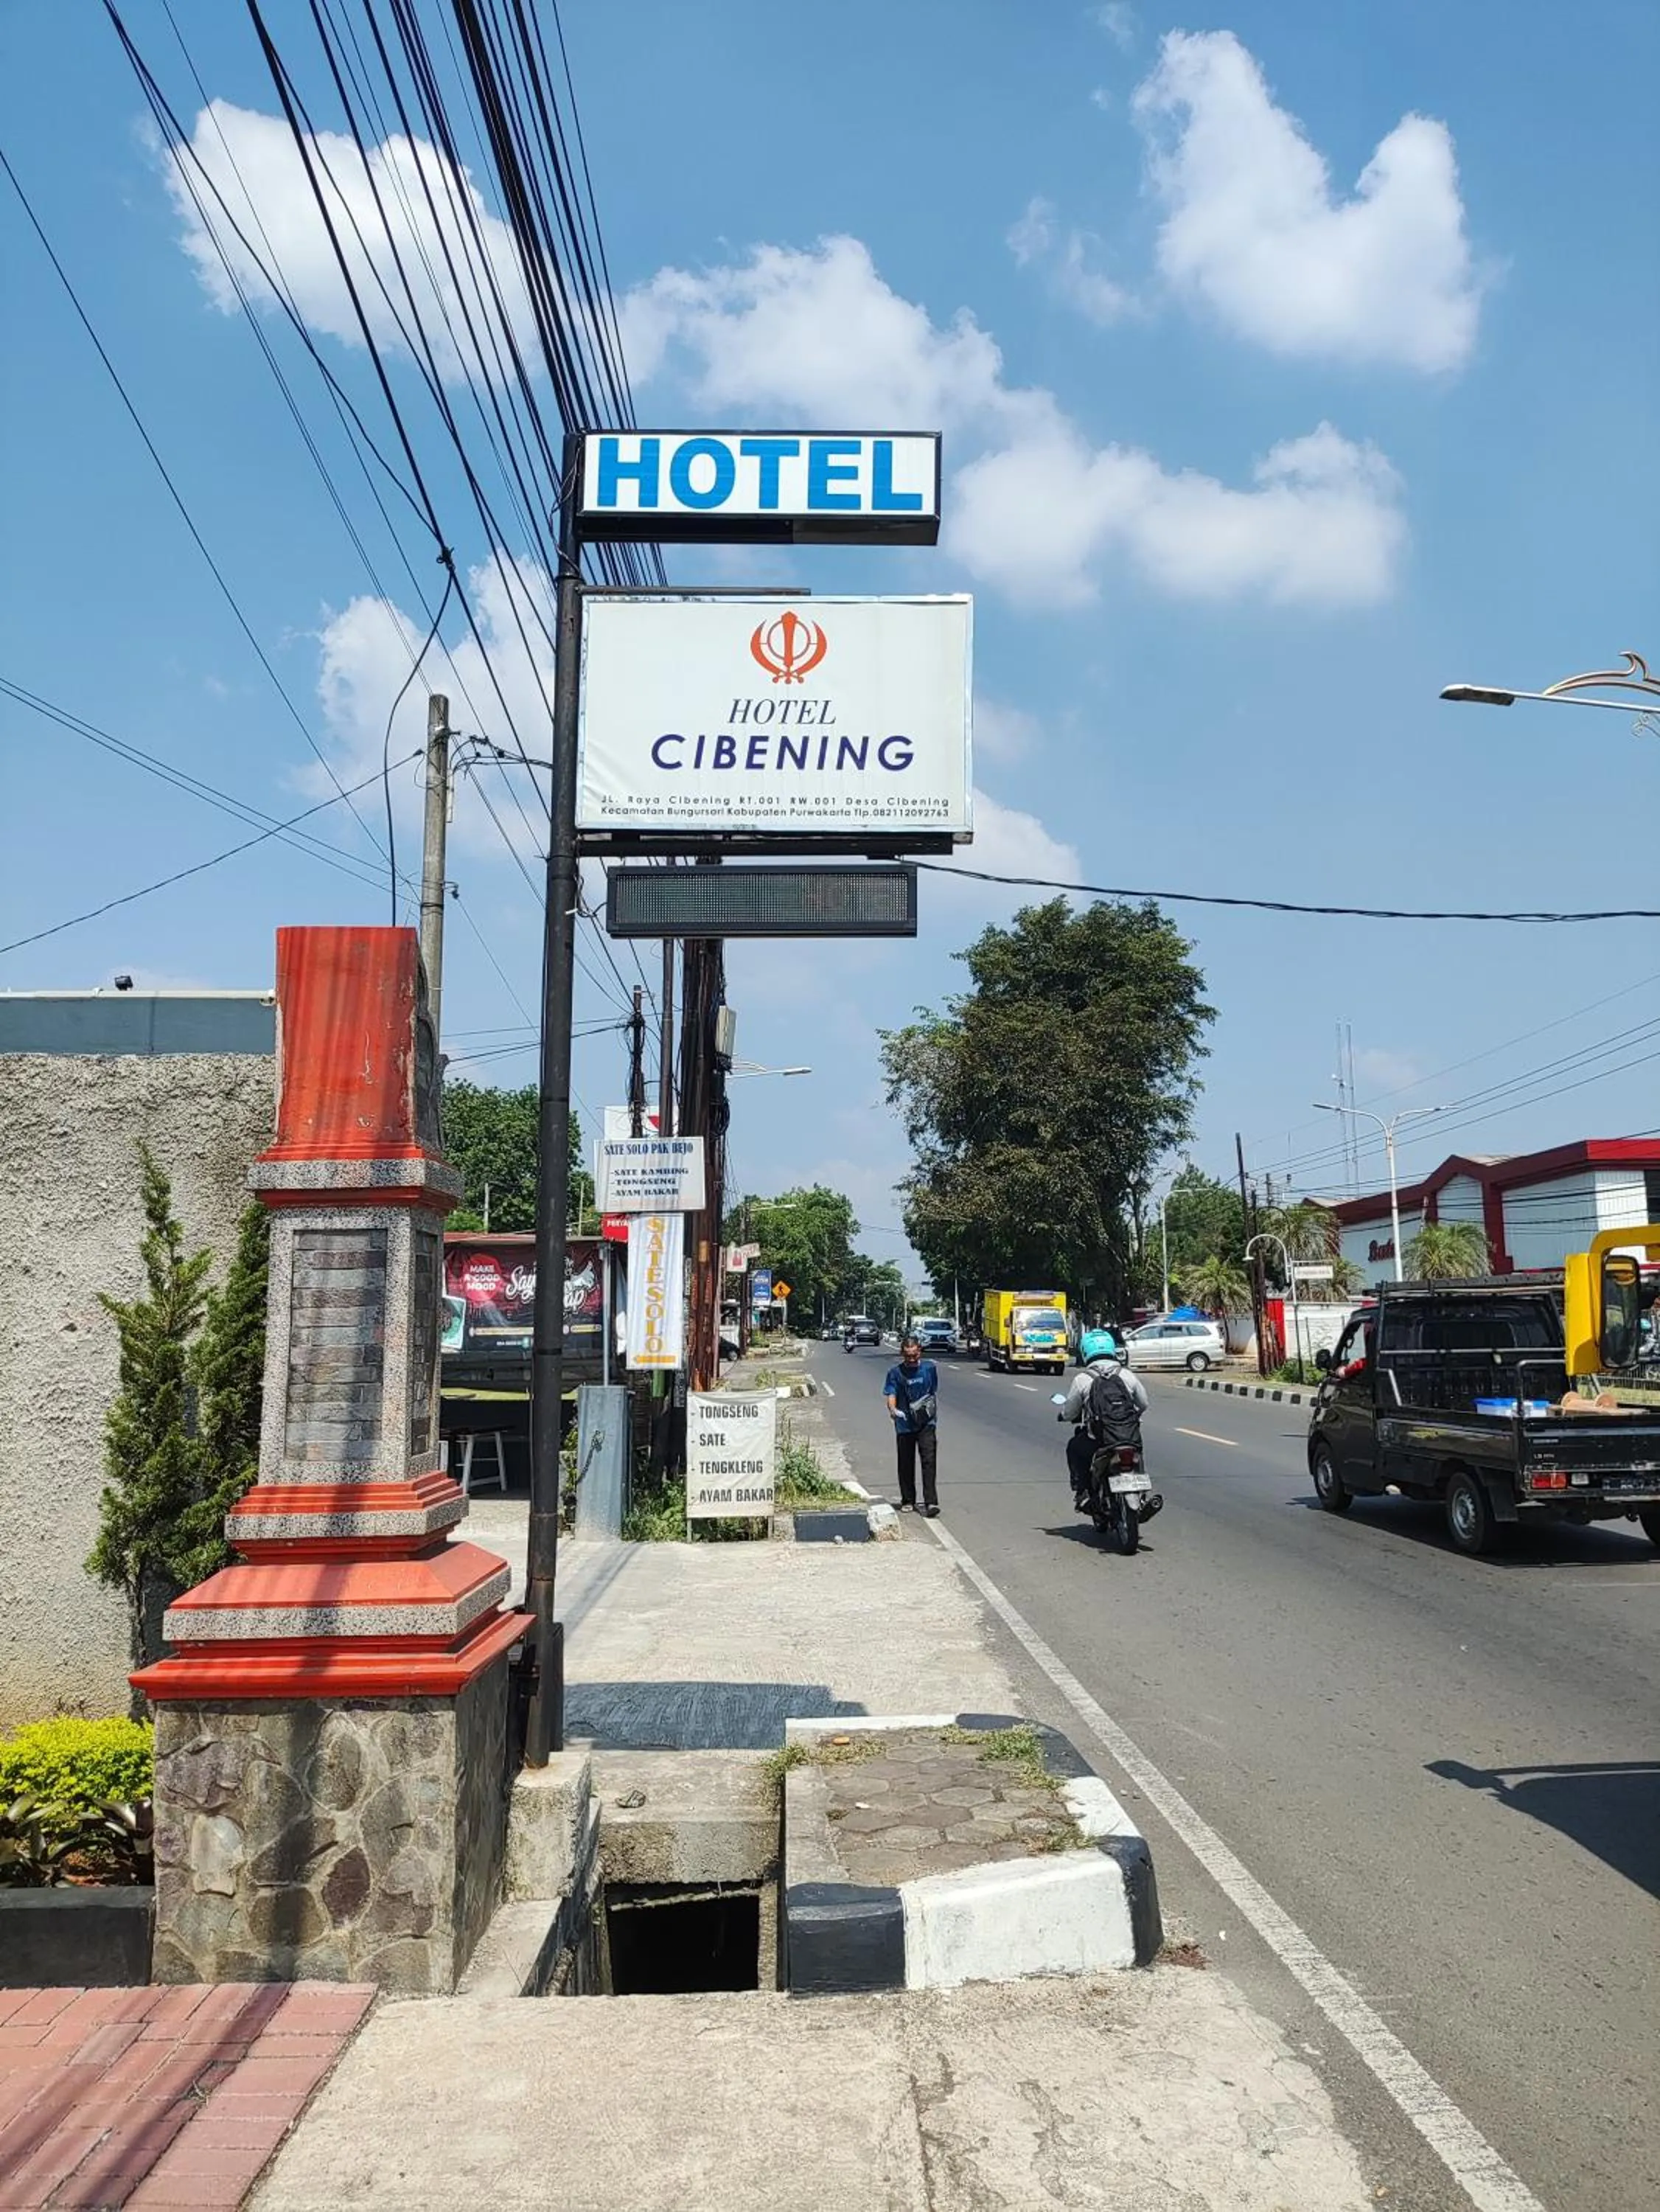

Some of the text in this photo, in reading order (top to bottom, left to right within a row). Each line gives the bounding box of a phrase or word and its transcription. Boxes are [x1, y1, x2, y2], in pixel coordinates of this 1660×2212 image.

[597, 437, 922, 510] HOTEL
[728, 698, 836, 724] HOTEL
[651, 734, 913, 771] CIBENING
[601, 796, 949, 807] JL. Raya Cibening RT.001 RW.001 Desa Cibening
[601, 806, 664, 815] Kecamatan
[667, 807, 724, 817] Bungursari
[727, 807, 787, 817] Kabupaten
[790, 807, 851, 816] Purwakarta
[604, 1144, 624, 1155] SATE
[627, 1144, 648, 1155] SOLO
[651, 1143, 669, 1154] PAK
[644, 1188, 679, 1196] BAKAR
[699, 1405, 758, 1419] TONGSENG
[699, 1433, 726, 1447] SATE
[699, 1460, 763, 1474] TENGKLENG
[700, 1487, 773, 1502] AYAM BAKAR
